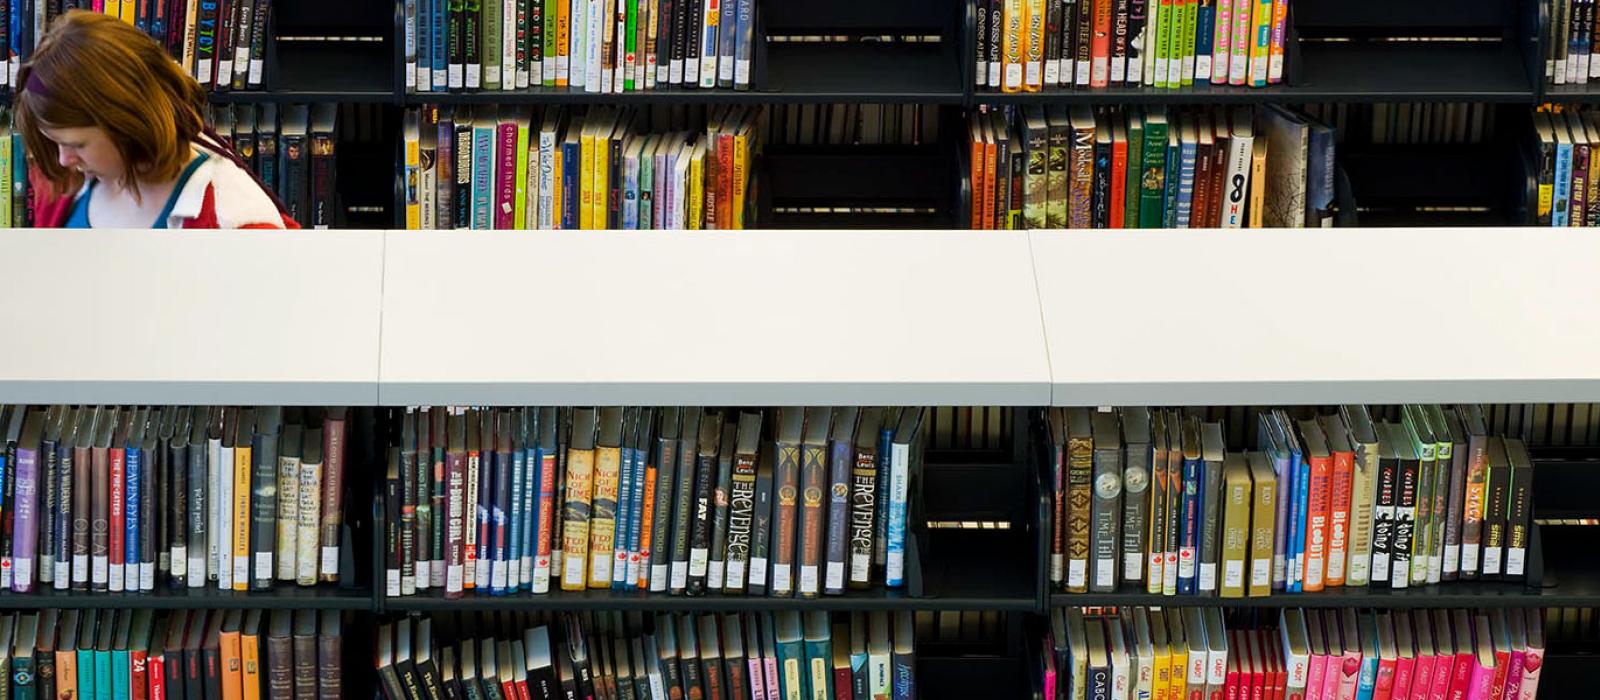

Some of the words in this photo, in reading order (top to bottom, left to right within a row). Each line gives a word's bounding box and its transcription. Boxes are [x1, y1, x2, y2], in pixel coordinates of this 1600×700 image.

[991, 11, 1001, 43] GENESIS
[1116, 12, 1127, 36] HEAD
[503, 126, 514, 167] charmed
[502, 171, 514, 200] thirds
[706, 192, 716, 224] HUSTLE
[1587, 179, 1599, 227] RUNNER
[126, 454, 138, 500] HEAVEN
[193, 488, 204, 510] picture
[593, 486, 617, 498] TIME
[1467, 487, 1482, 524] SMACK
[126, 502, 138, 530] EYES
[659, 492, 669, 525] GOBLIN
[678, 495, 689, 528] GOBLIN
[697, 498, 708, 521] FAT
[1126, 504, 1139, 530] TIME
[74, 518, 88, 555] CLA
[92, 518, 107, 555] CLA
[449, 518, 462, 544] GIRL
[1098, 510, 1113, 538] TIME
[1374, 521, 1392, 551] doing
[1393, 522, 1412, 551] doing
[1489, 524, 1500, 547] sma
[1511, 524, 1523, 548] sma
[656, 527, 667, 553] WOOD
[675, 530, 687, 556] WOOD
[133, 657, 146, 673] 24
[1093, 672, 1107, 700] CABO
